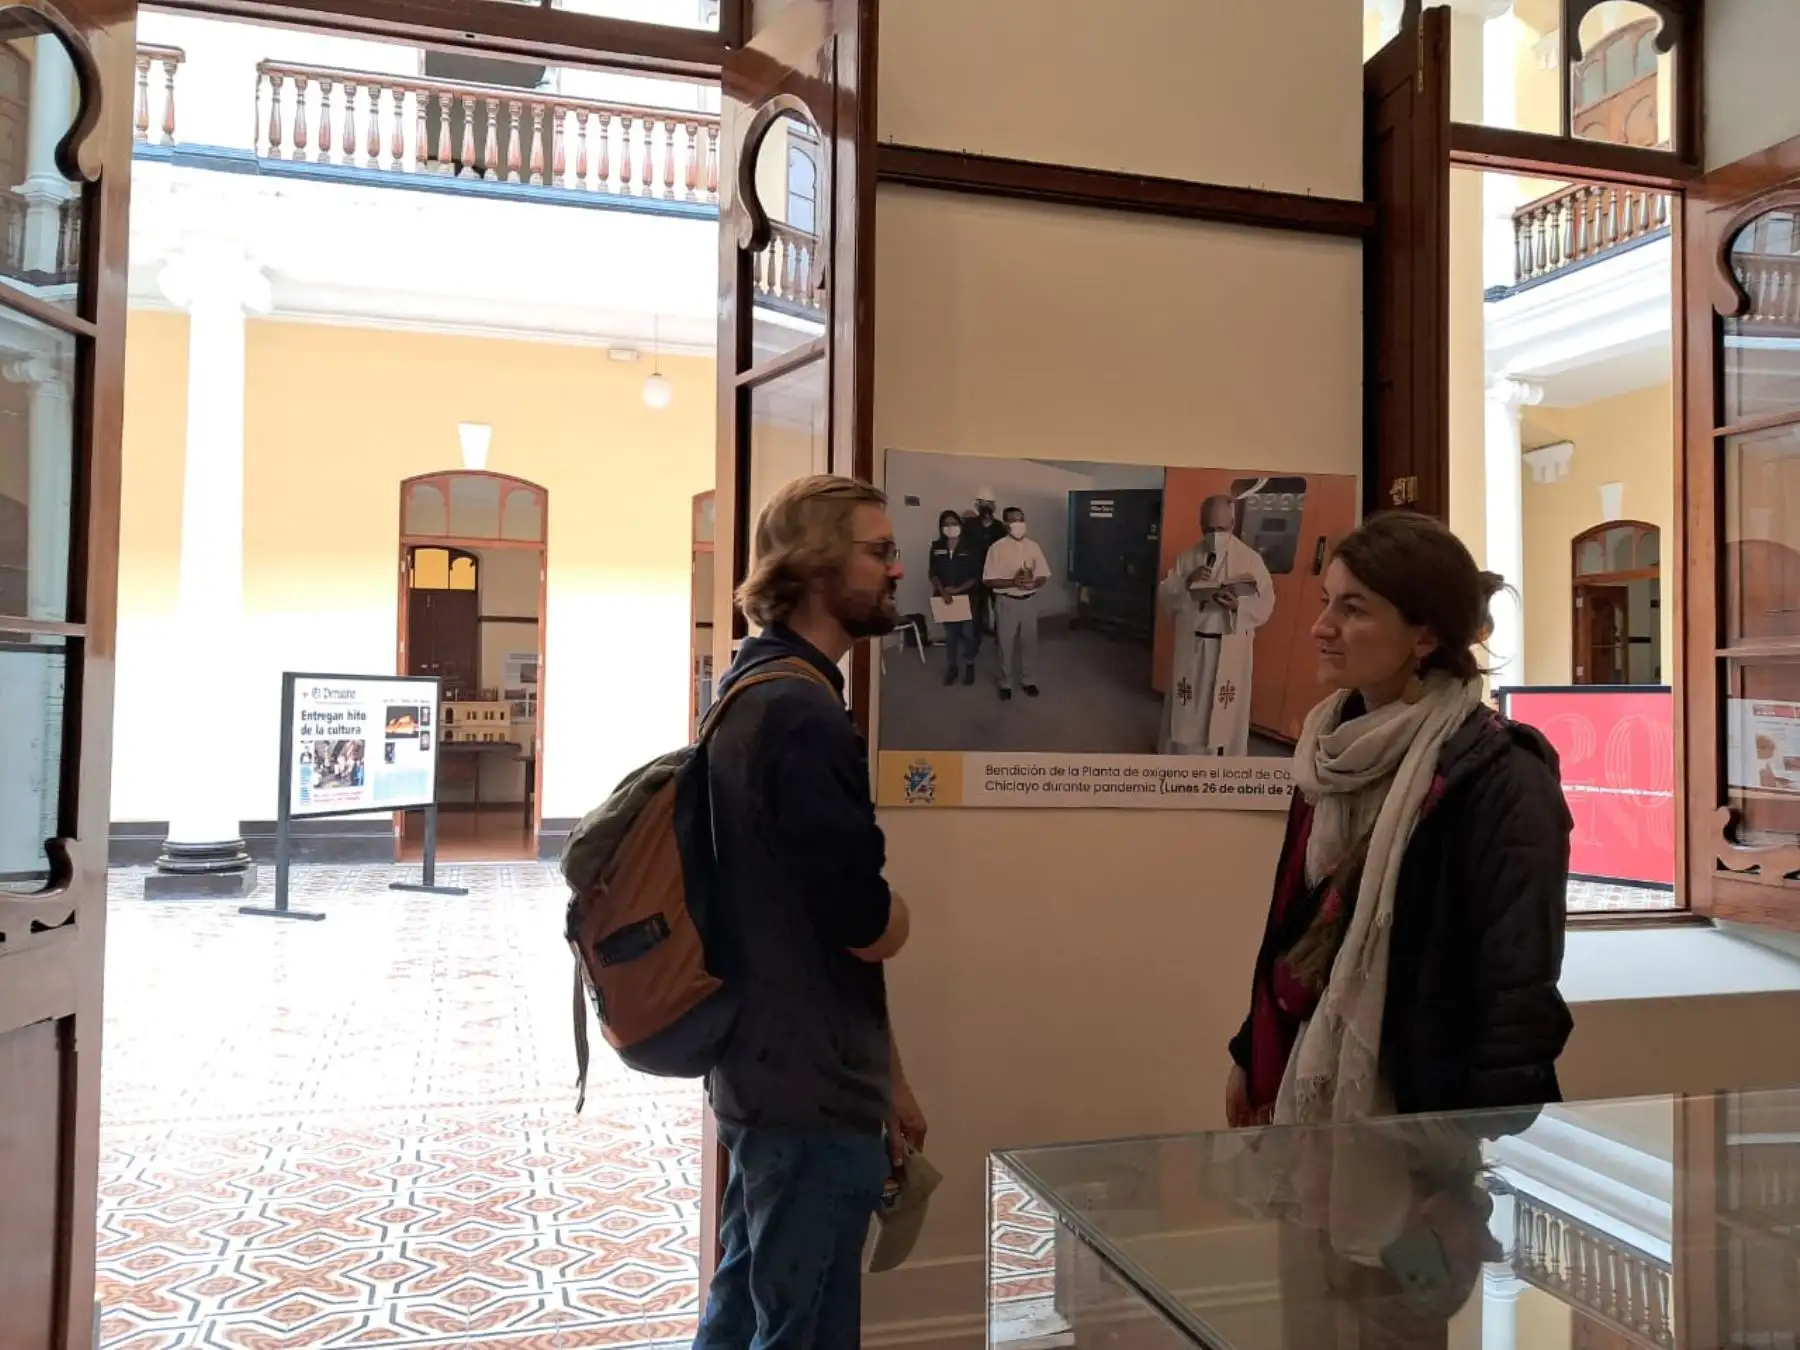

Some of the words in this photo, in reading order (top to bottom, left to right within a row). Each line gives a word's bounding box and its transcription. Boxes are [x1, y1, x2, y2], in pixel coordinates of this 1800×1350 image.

[301, 709, 344, 724] Entregan
[346, 709, 367, 721] hito
[300, 723, 312, 735] de
[315, 723, 324, 735] la
[327, 723, 362, 735] cultura
[985, 764, 1046, 776] Bendición
[1049, 765, 1065, 777] de
[1068, 765, 1080, 777] la
[1082, 765, 1120, 777] Planta
[1123, 766, 1140, 777] de
[1142, 767, 1189, 781] oxígeno
[1191, 769, 1207, 779] en
[1209, 768, 1220, 779] el
[1222, 768, 1252, 779] local
[1255, 769, 1271, 780] de
[985, 780, 1040, 794] Chiclayo
[1042, 780, 1091, 792] durante
[1159, 780, 1200, 795] (Lunes
[1201, 783, 1217, 794] 26
[1219, 783, 1235, 794] de
[1237, 783, 1265, 795] abril
[1267, 783, 1284, 795] de
